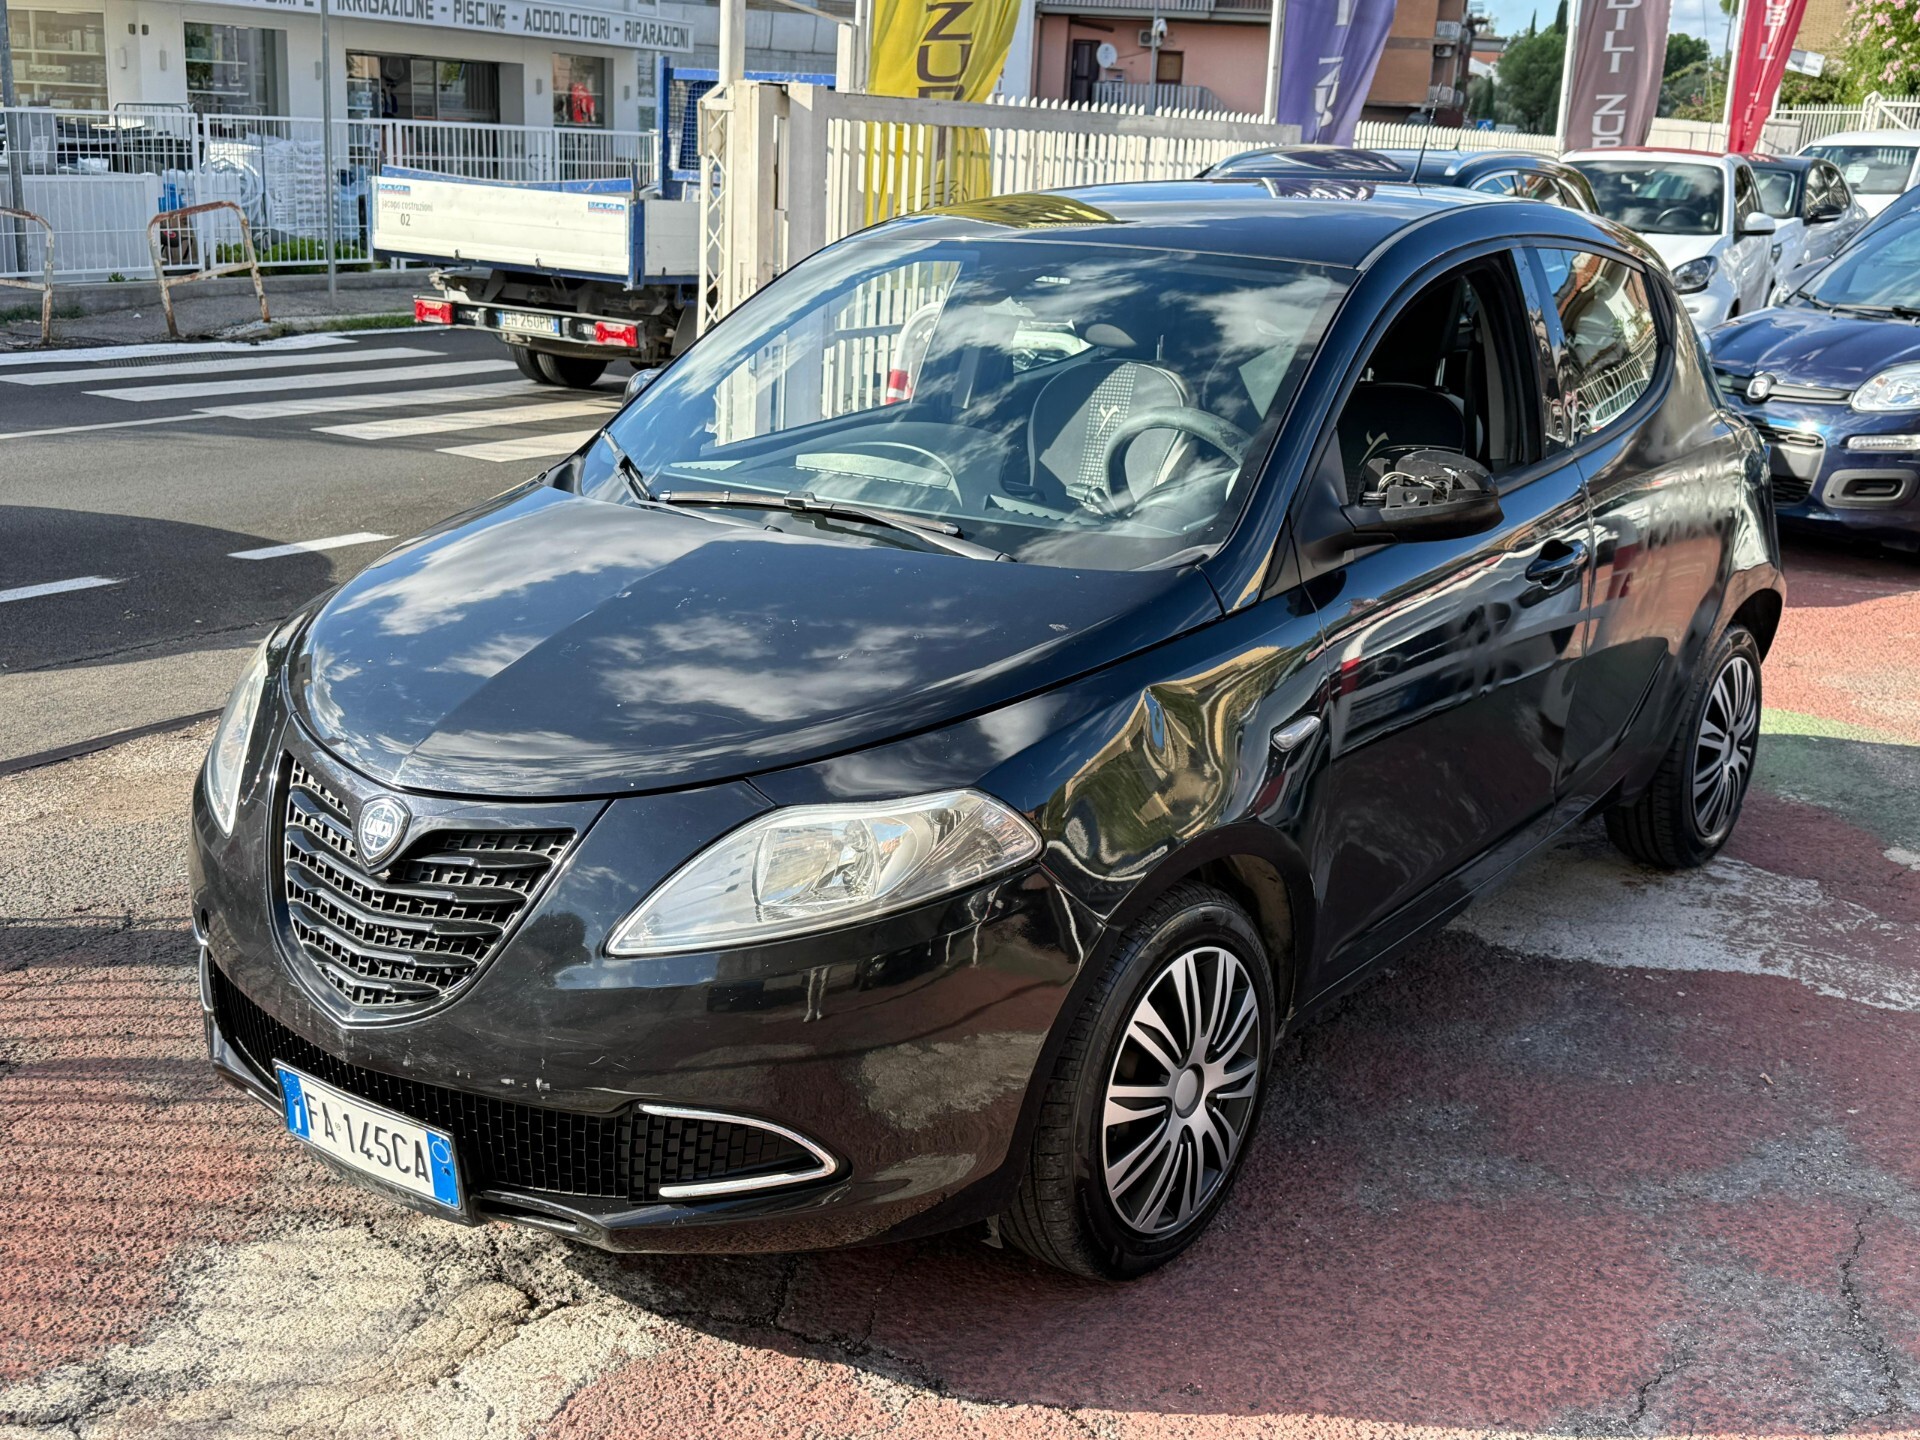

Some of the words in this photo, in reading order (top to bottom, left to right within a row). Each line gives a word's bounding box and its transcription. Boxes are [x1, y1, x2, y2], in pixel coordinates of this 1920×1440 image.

[453, 0, 506, 28] PISCINE
[524, 8, 610, 39] ADDOLCITORI
[624, 20, 689, 49] RIPARAZIONI
[400, 212, 412, 227] 02
